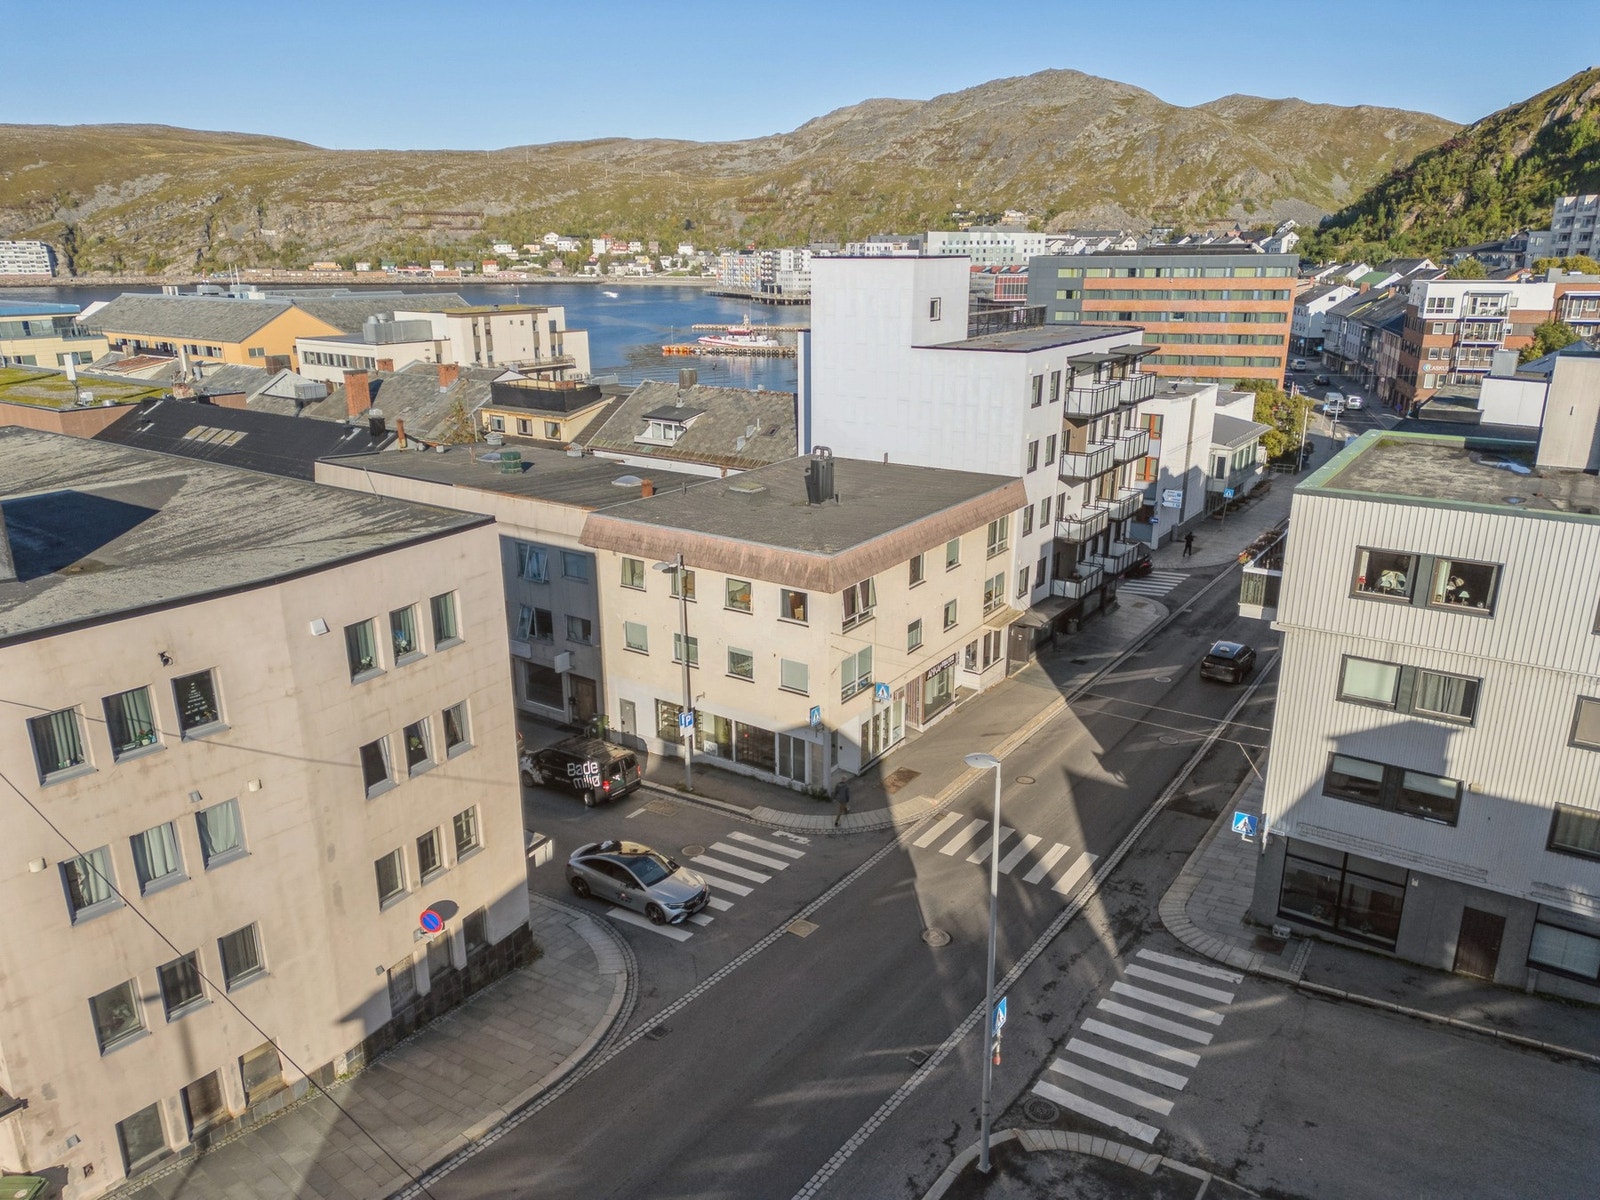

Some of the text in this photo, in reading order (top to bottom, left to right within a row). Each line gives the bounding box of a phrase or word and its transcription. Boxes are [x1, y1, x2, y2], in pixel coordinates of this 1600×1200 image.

[685, 715, 691, 726] P
[567, 761, 598, 777] Bade
[572, 772, 601, 790] miljø
